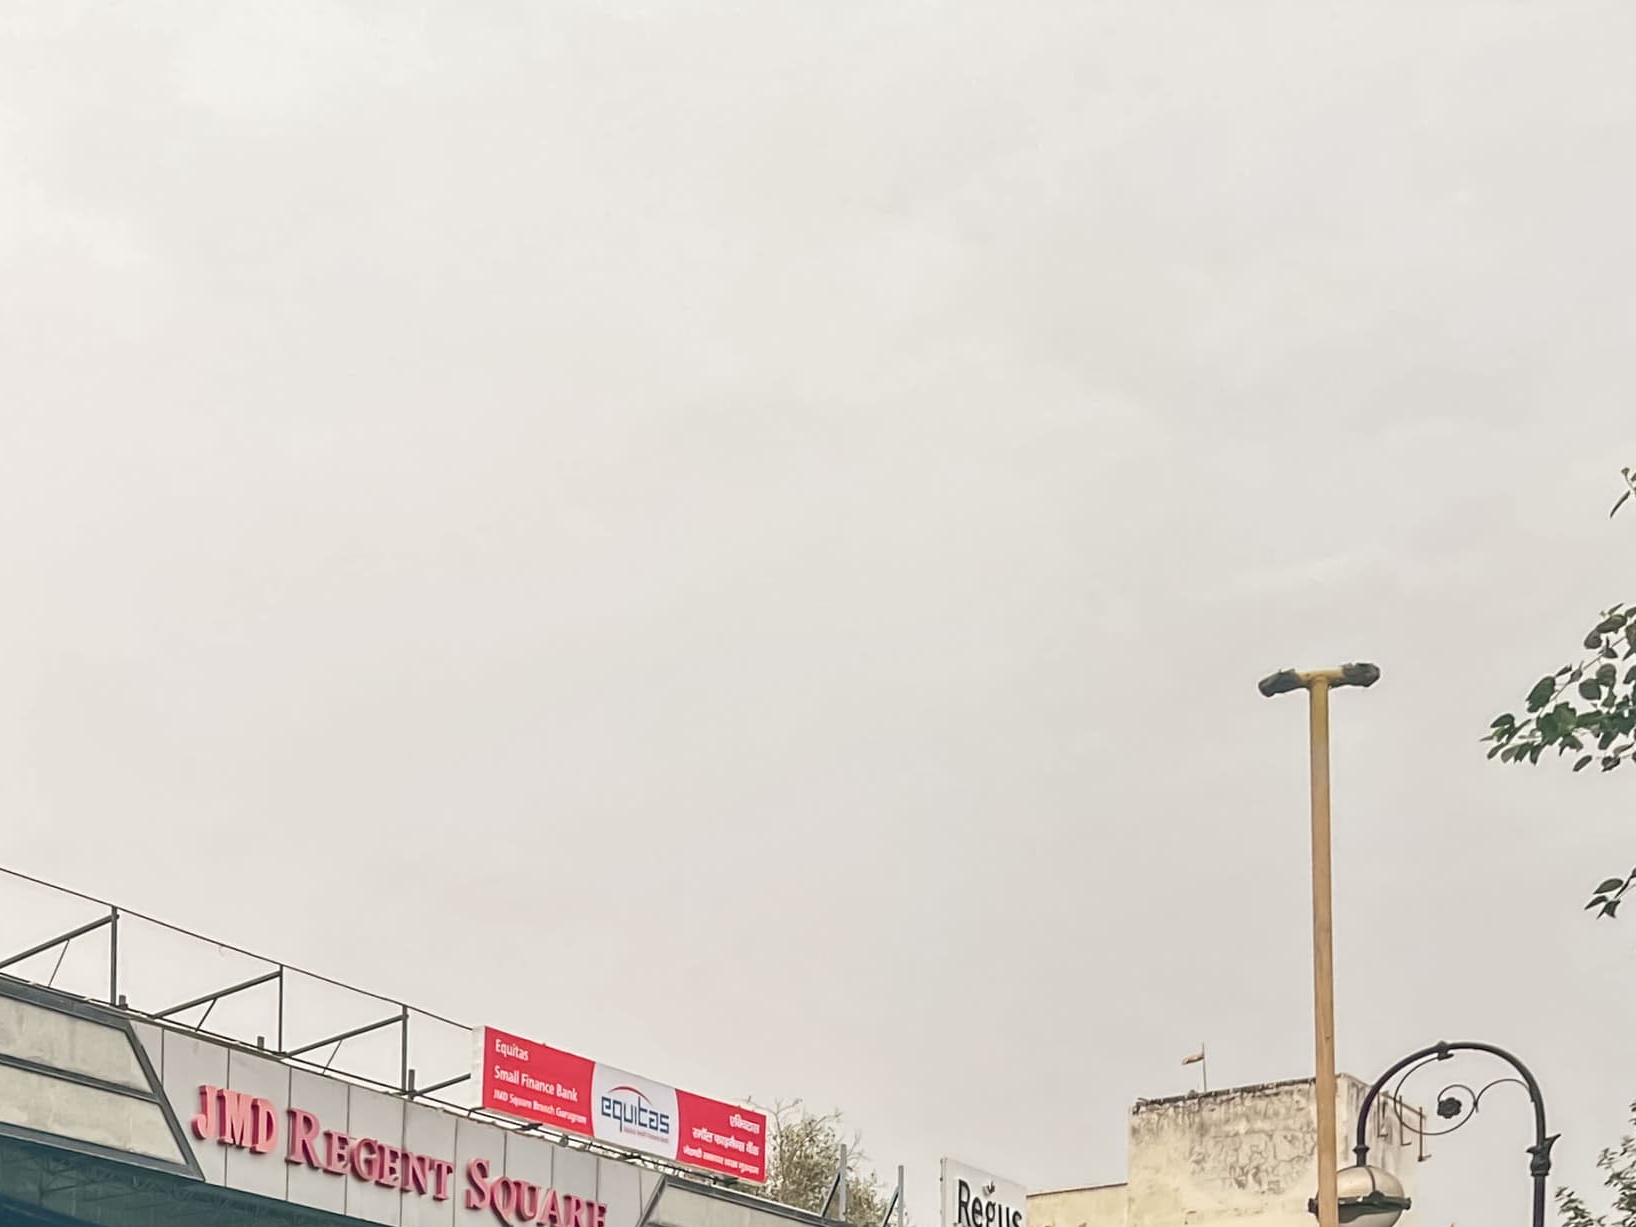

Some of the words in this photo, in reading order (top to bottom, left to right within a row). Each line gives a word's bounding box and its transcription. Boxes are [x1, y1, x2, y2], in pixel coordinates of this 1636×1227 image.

[495, 1039, 529, 1061] Equitas
[494, 1065, 520, 1086] Small
[521, 1073, 555, 1096] Finance
[556, 1083, 579, 1103] Bank
[192, 1084, 278, 1155] JMD
[601, 1095, 670, 1135] equitas
